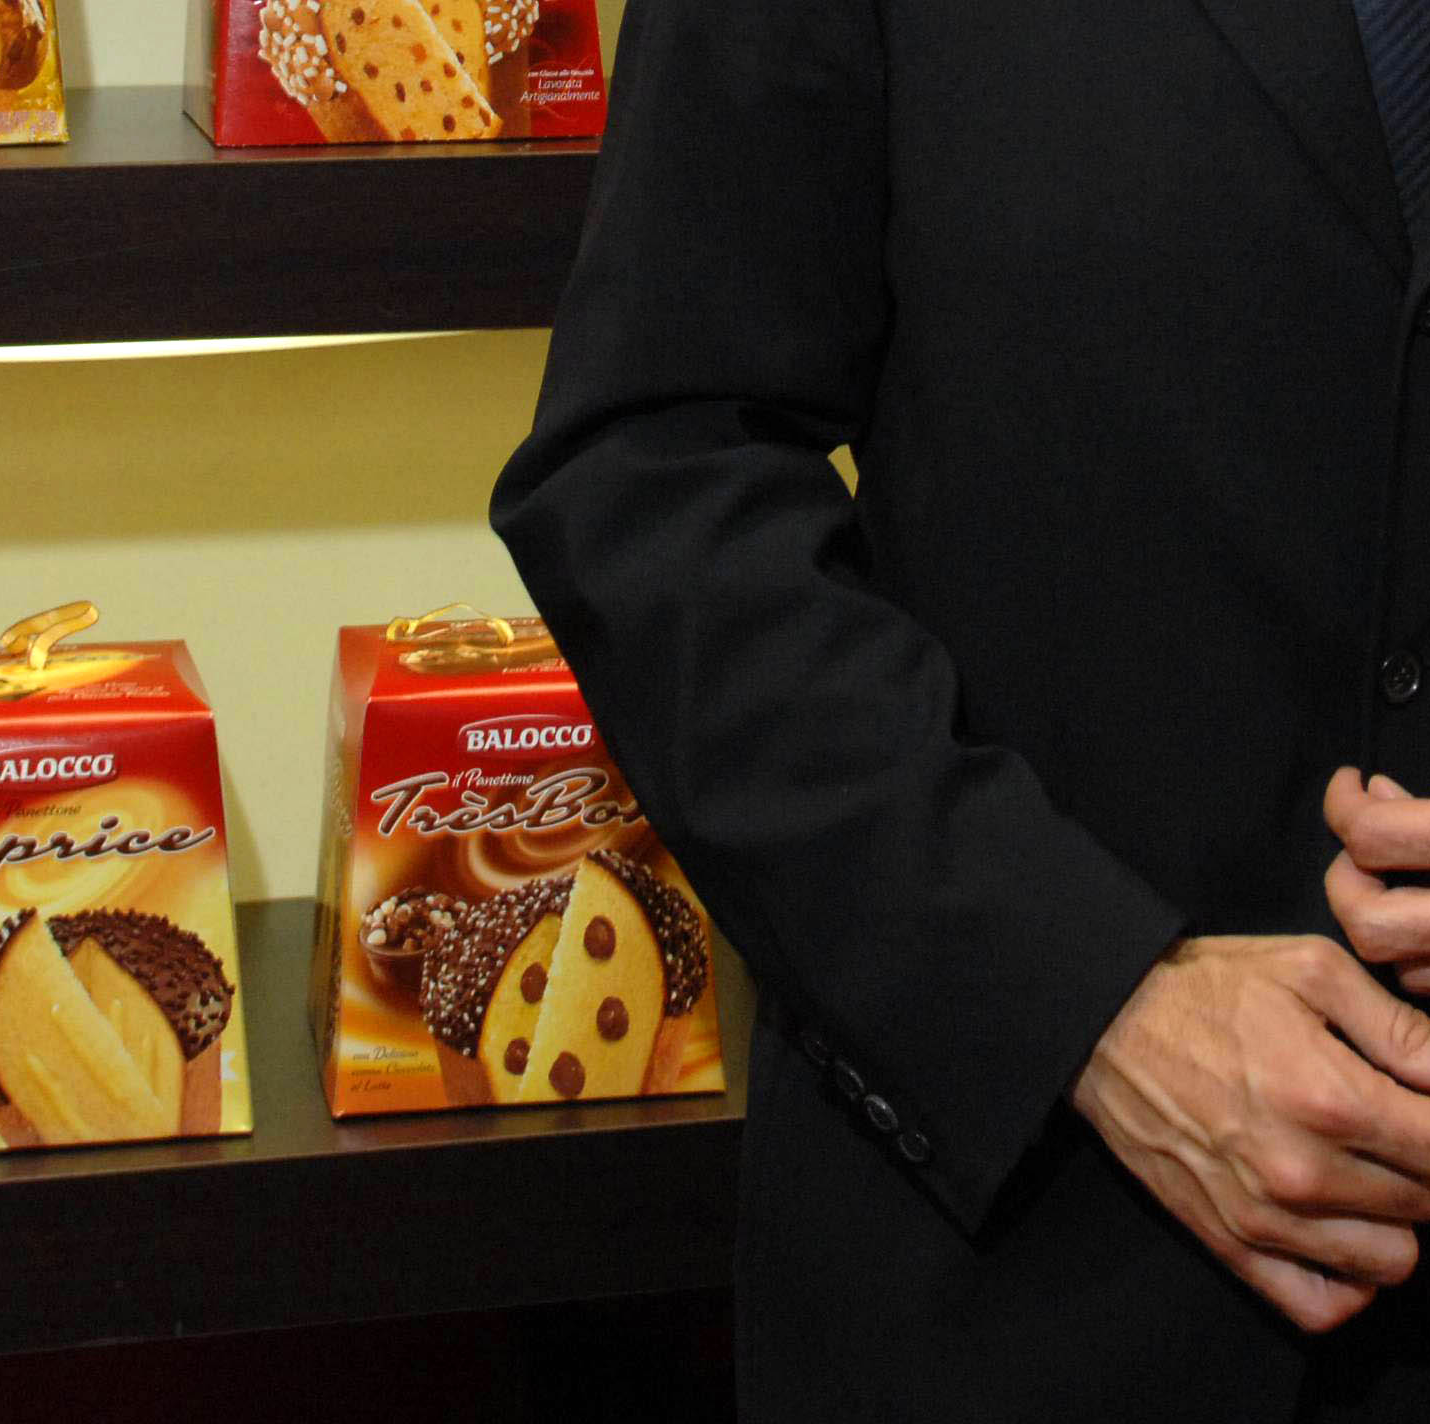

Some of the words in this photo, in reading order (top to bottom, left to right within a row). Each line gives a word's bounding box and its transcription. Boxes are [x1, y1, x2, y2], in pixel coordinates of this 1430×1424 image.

[538, 78, 583, 89] Lavorata
[519, 90, 601, 105] Artigianalmente
[466, 724, 592, 753] BALOCCO
[452, 771, 463, 789] il
[465, 768, 534, 789] Panettone
